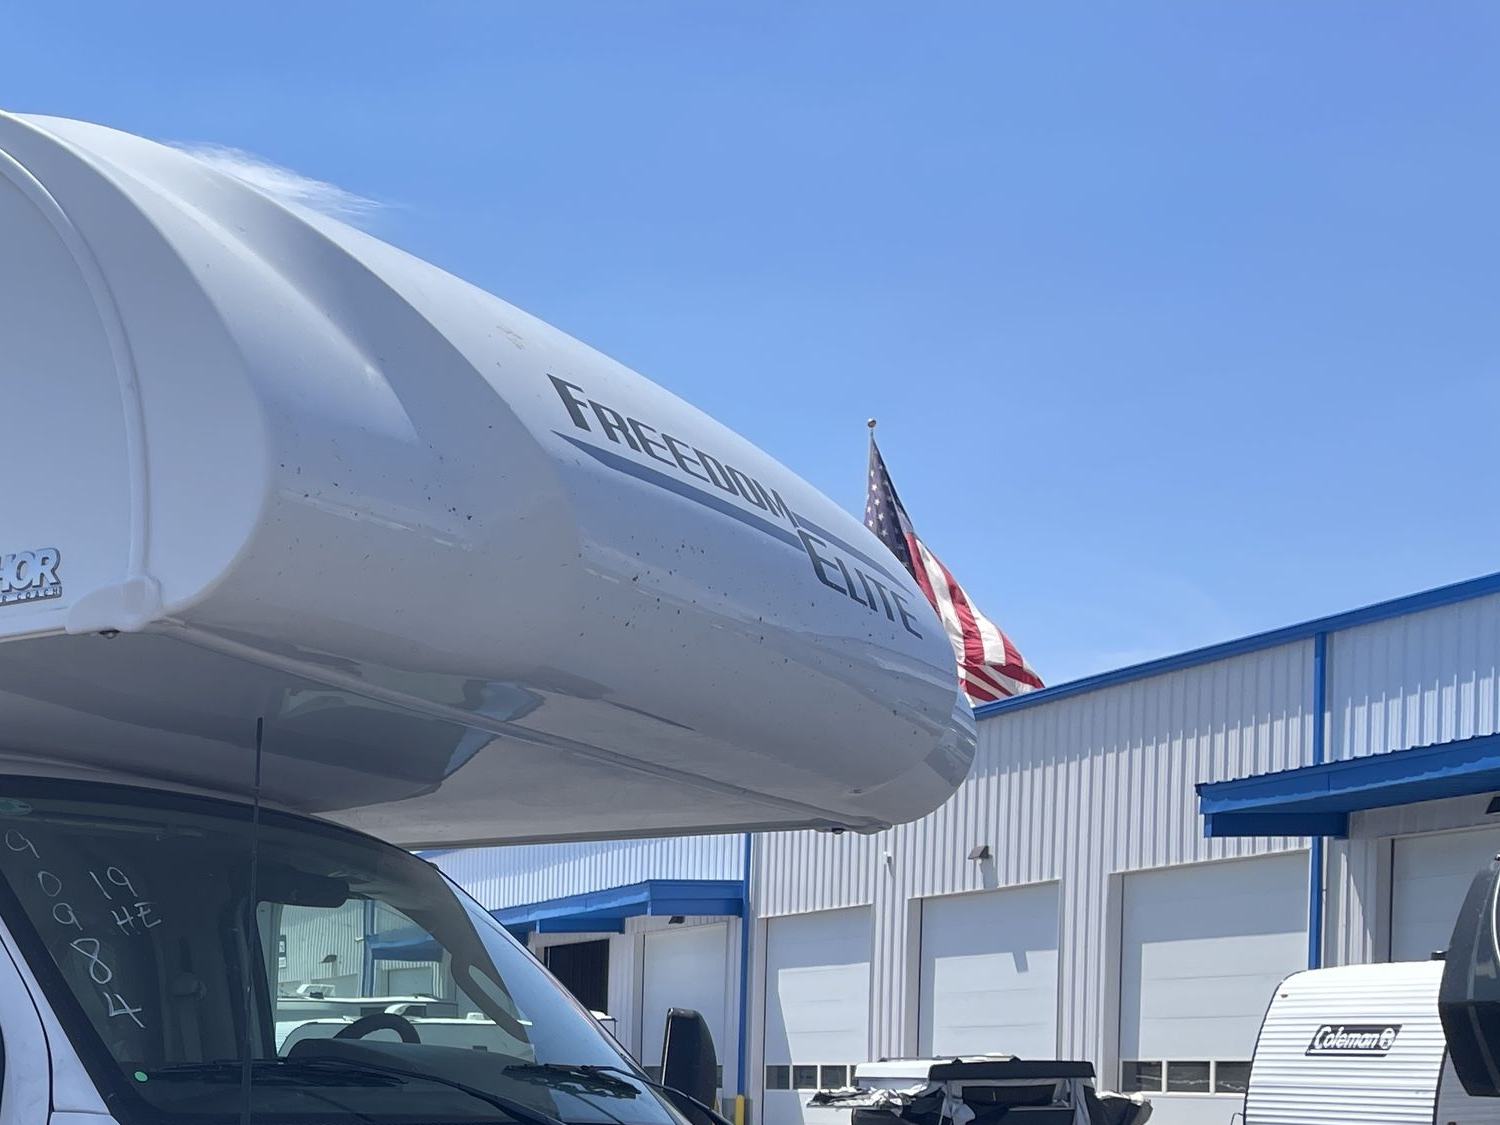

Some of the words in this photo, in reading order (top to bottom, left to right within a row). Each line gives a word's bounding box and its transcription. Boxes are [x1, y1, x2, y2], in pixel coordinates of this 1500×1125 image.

[546, 373, 799, 528] FREEDOM
[16, 587, 61, 601] COACH
[797, 527, 924, 641] ELITE
[1314, 1025, 1380, 1049] Coleman
